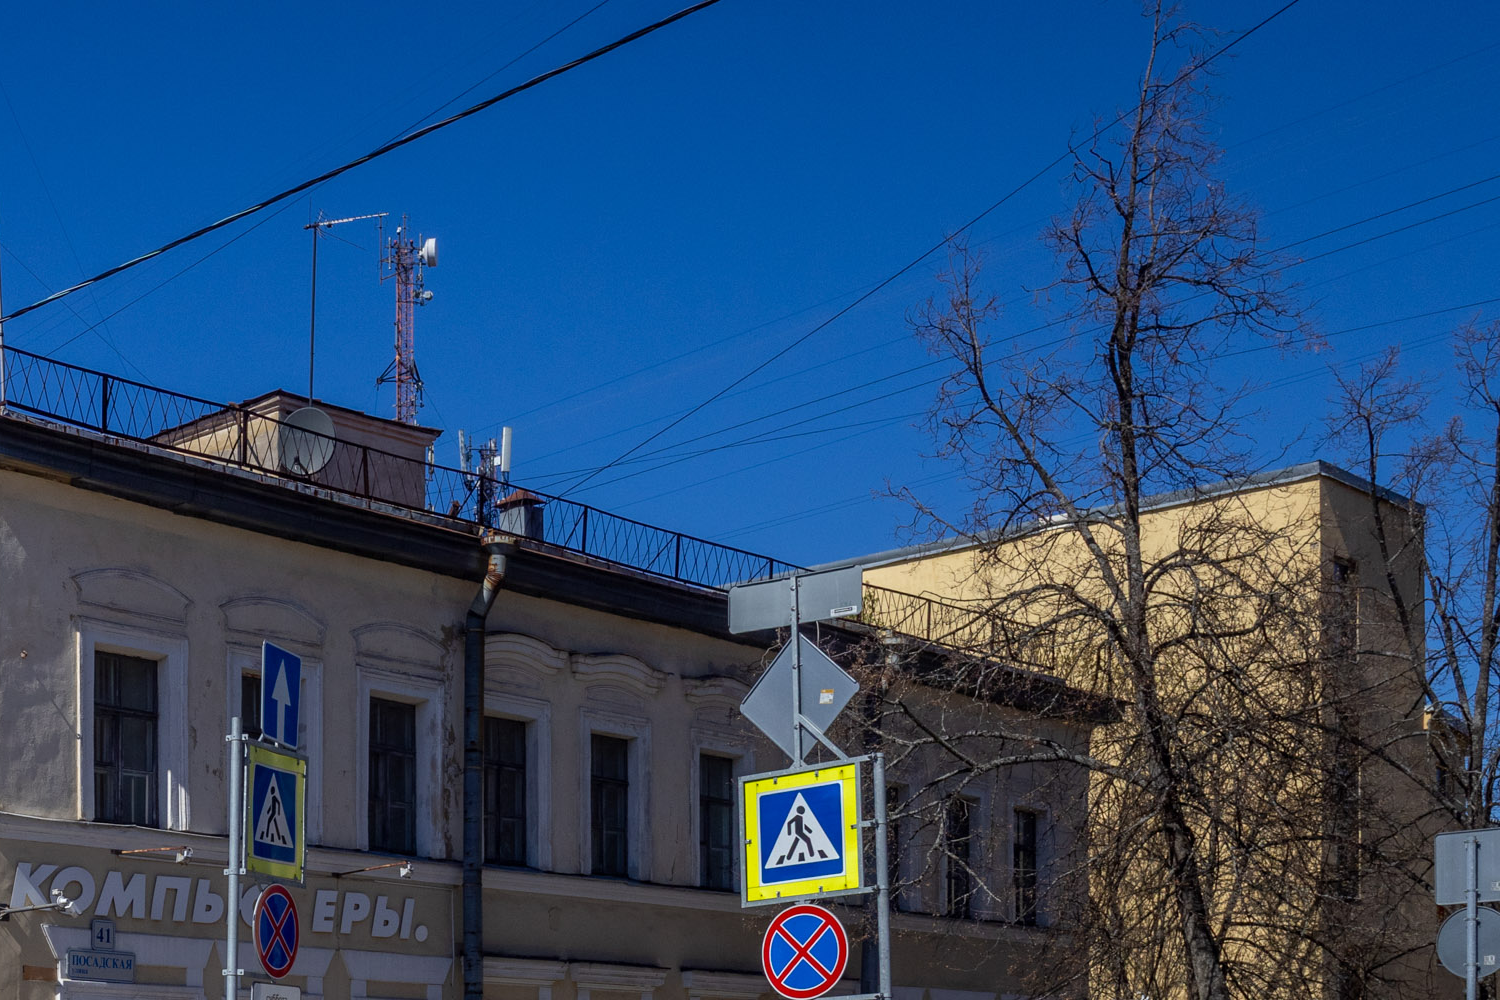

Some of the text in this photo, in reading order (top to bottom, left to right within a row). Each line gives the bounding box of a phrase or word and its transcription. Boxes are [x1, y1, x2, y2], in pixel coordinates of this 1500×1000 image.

[10, 862, 428, 942] КОМПЬЕРЫ.
[96, 927, 110, 943] 41
[72, 954, 132, 970] ПОСАДСКАЯ
